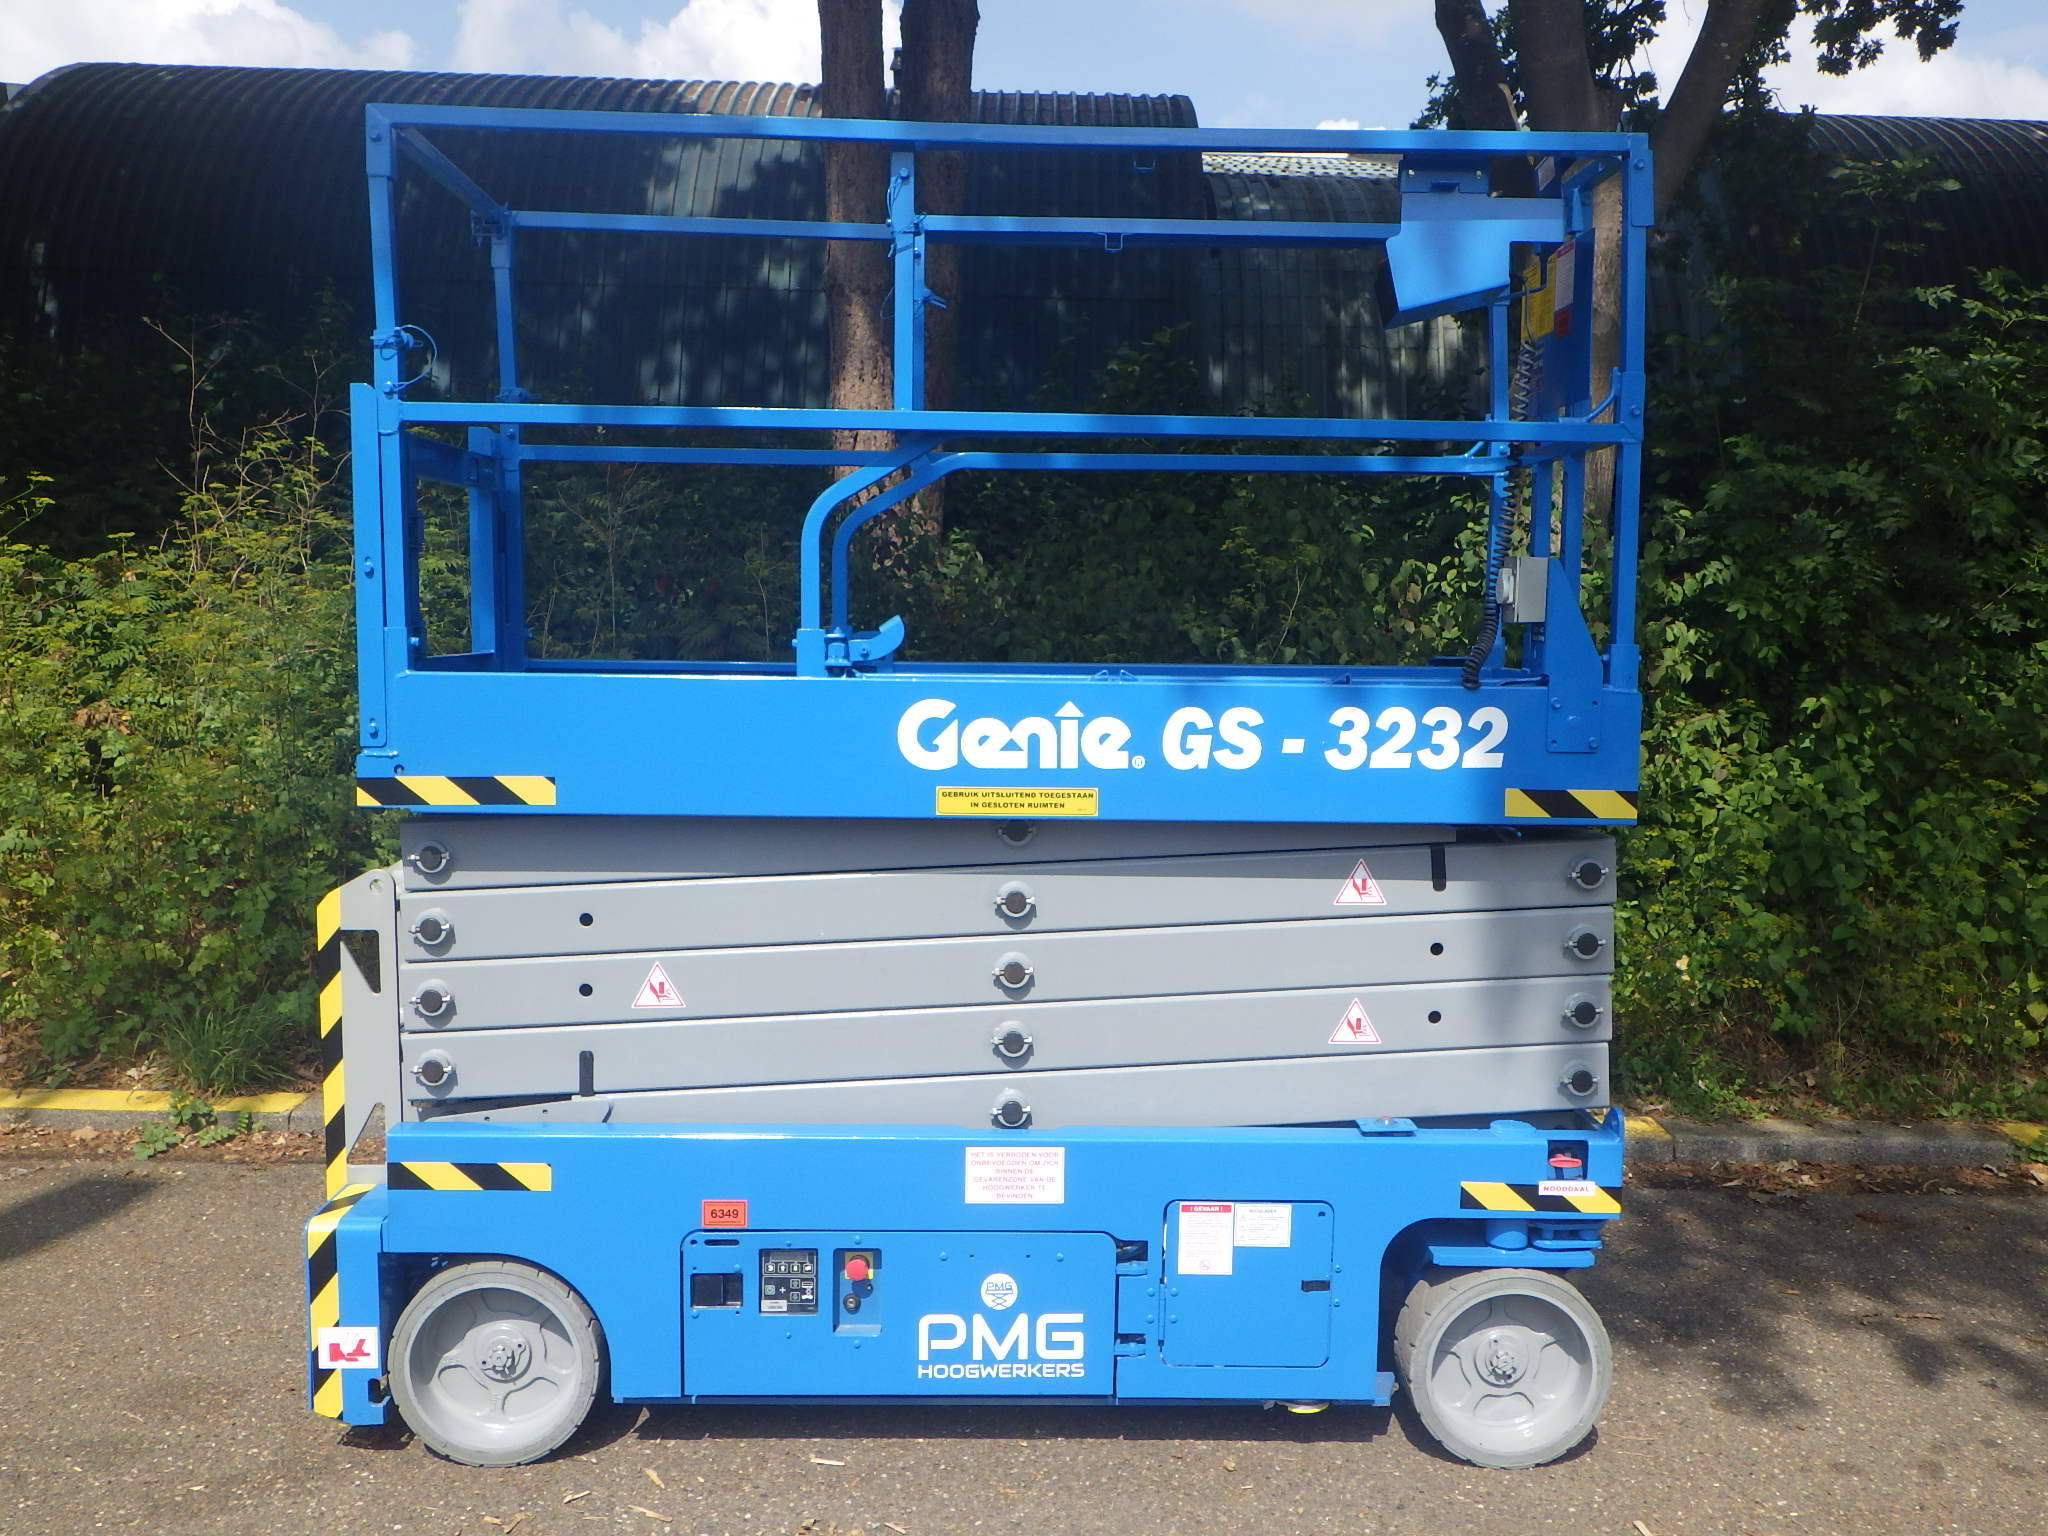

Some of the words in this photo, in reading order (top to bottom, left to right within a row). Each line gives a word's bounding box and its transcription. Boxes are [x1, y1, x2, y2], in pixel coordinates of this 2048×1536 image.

[1162, 706, 1265, 770] GS
[1324, 706, 1508, 770] 3232
[981, 791, 1037, 799] UITSLUITEND
[711, 1209, 739, 1219] 6349
[986, 1281, 1013, 1291] PMG
[918, 1313, 1084, 1360] PMG
[917, 1364, 1085, 1378] HOOGWERKERS
